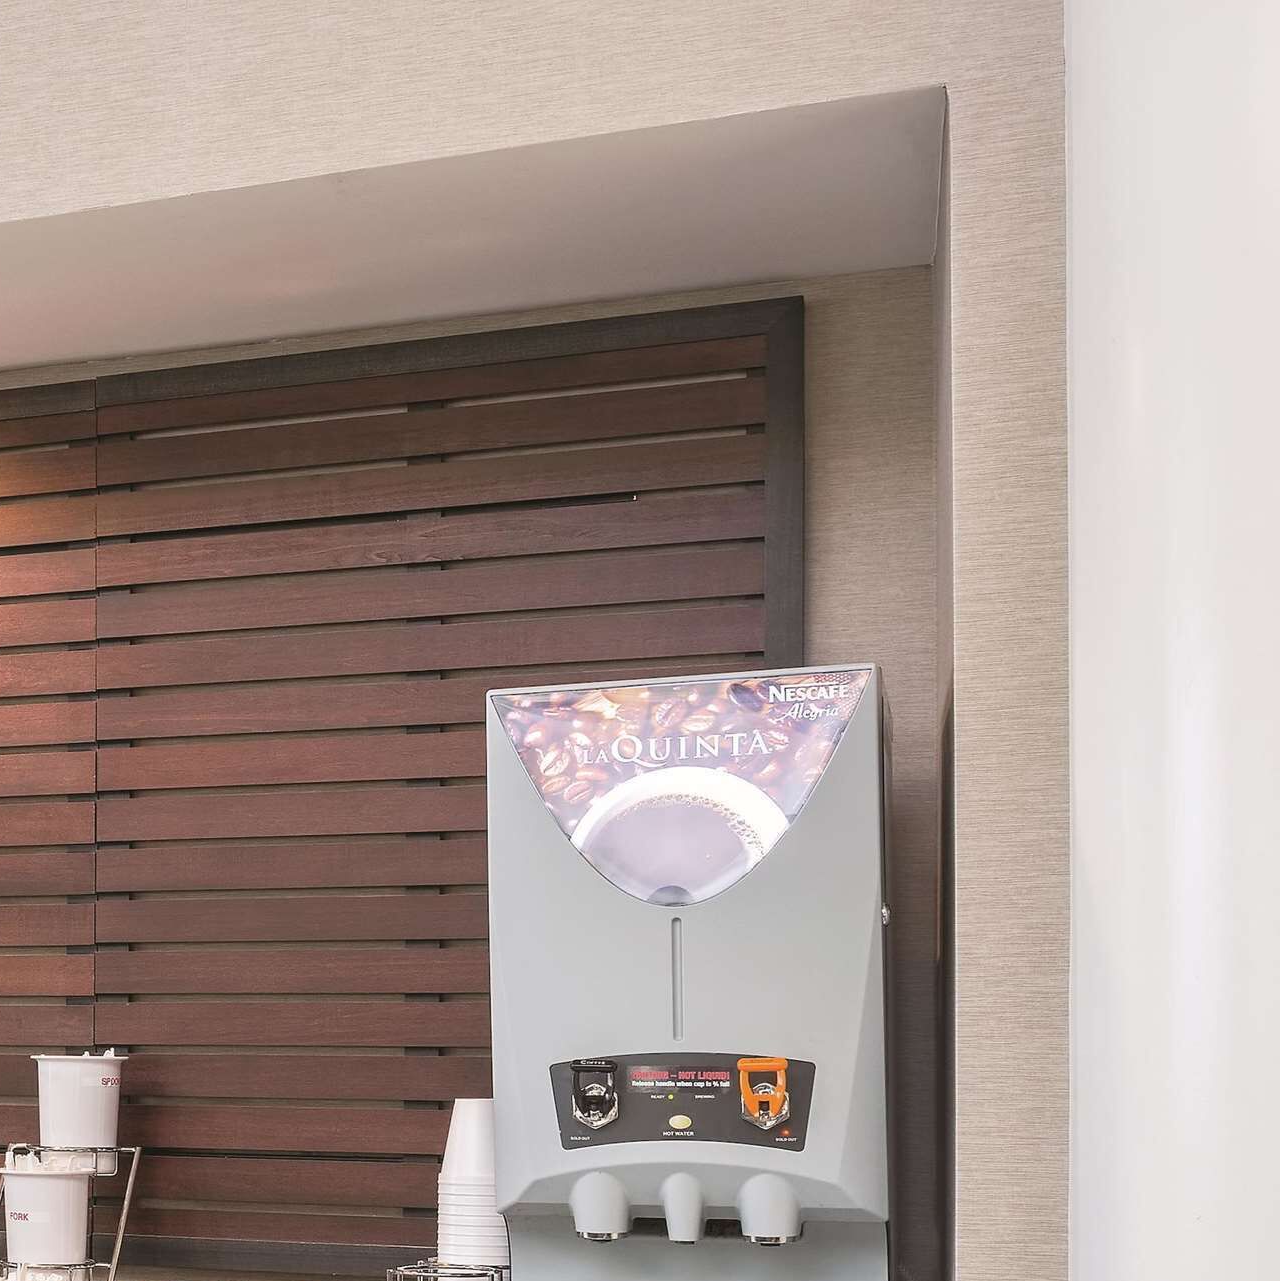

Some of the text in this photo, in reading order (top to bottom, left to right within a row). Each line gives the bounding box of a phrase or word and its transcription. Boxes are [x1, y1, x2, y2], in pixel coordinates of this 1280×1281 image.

[583, 730, 773, 768] LA QUINTA
[10, 1211, 30, 1221] FORK
